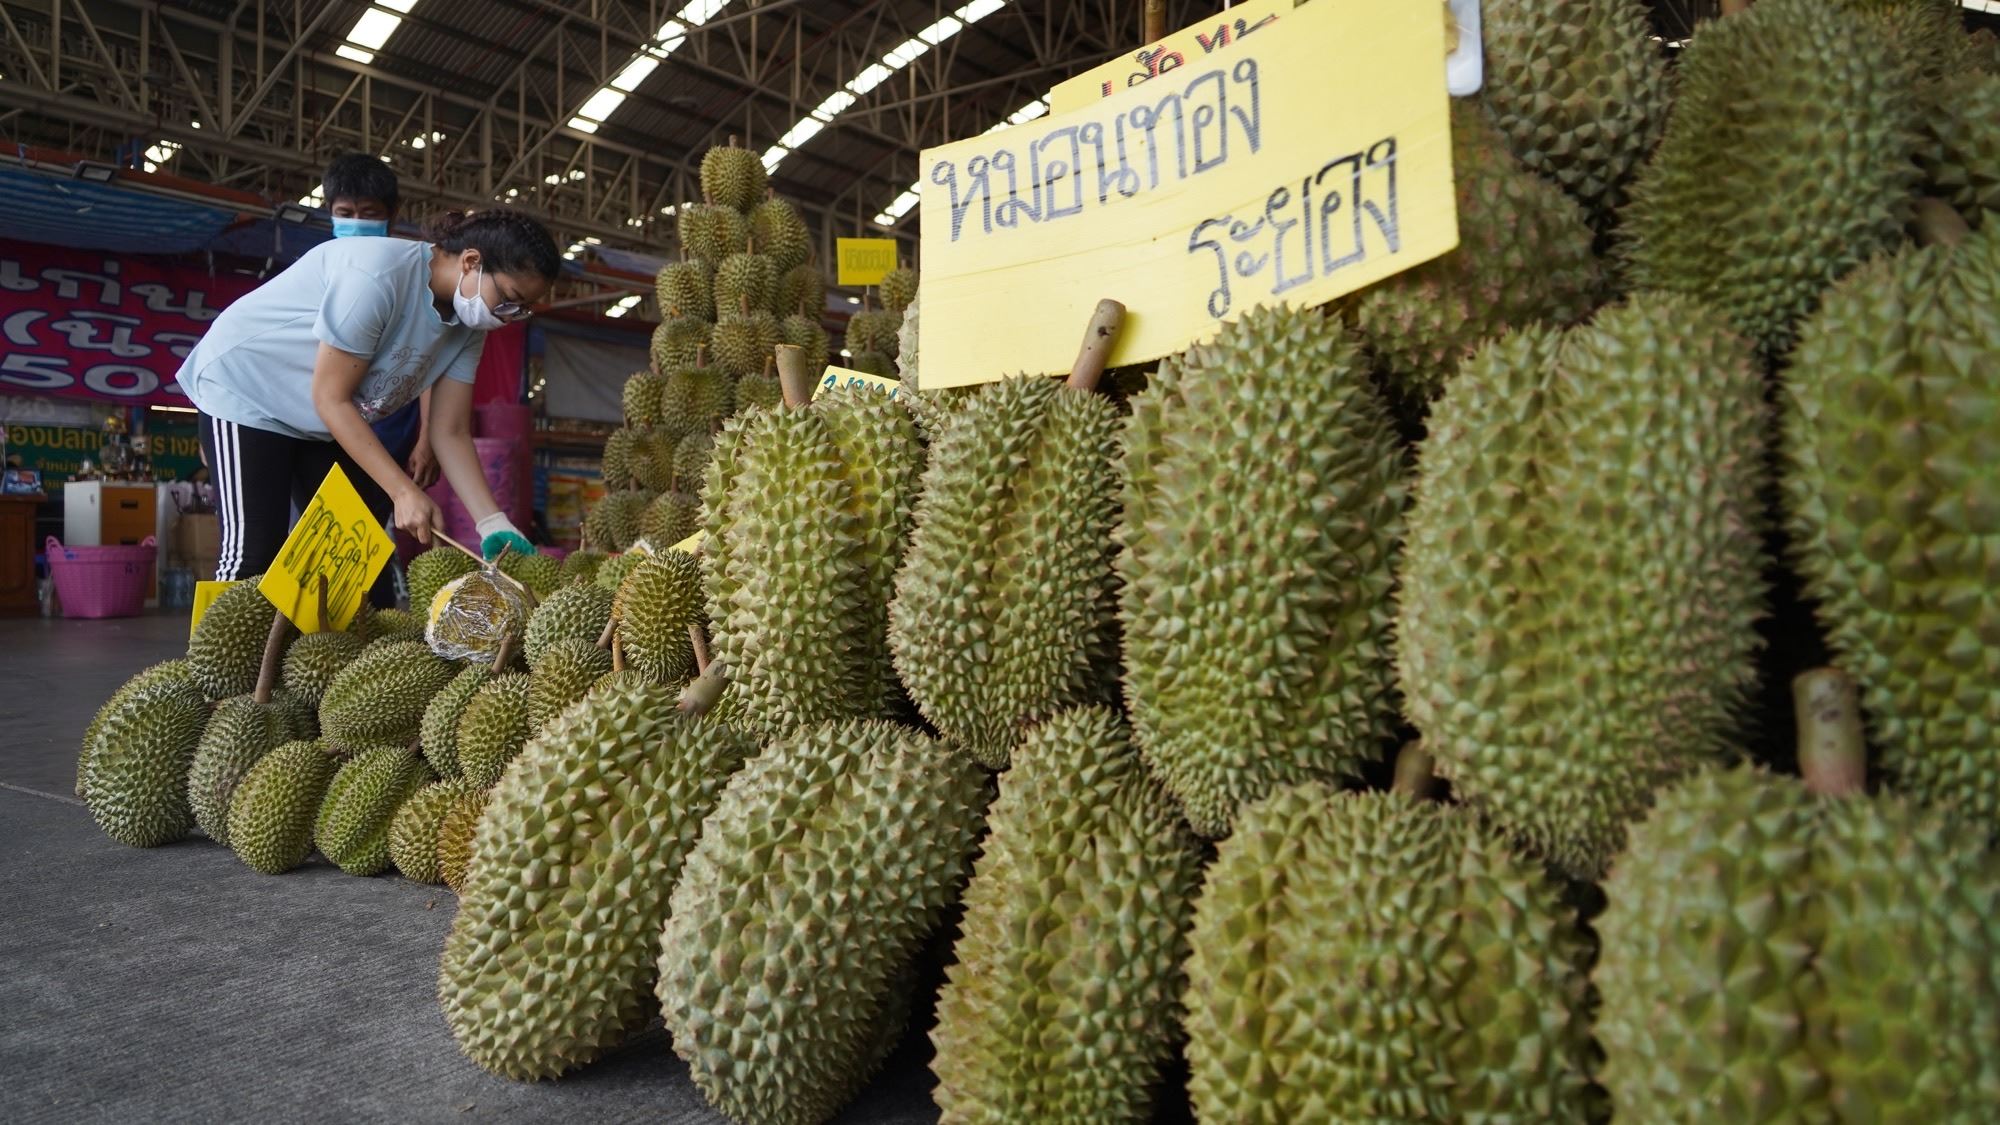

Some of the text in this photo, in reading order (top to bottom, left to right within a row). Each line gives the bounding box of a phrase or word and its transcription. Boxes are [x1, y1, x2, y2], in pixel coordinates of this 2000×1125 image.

[931, 57, 1261, 242] หมอนทอง
[1188, 136, 1400, 319] ระยอง
